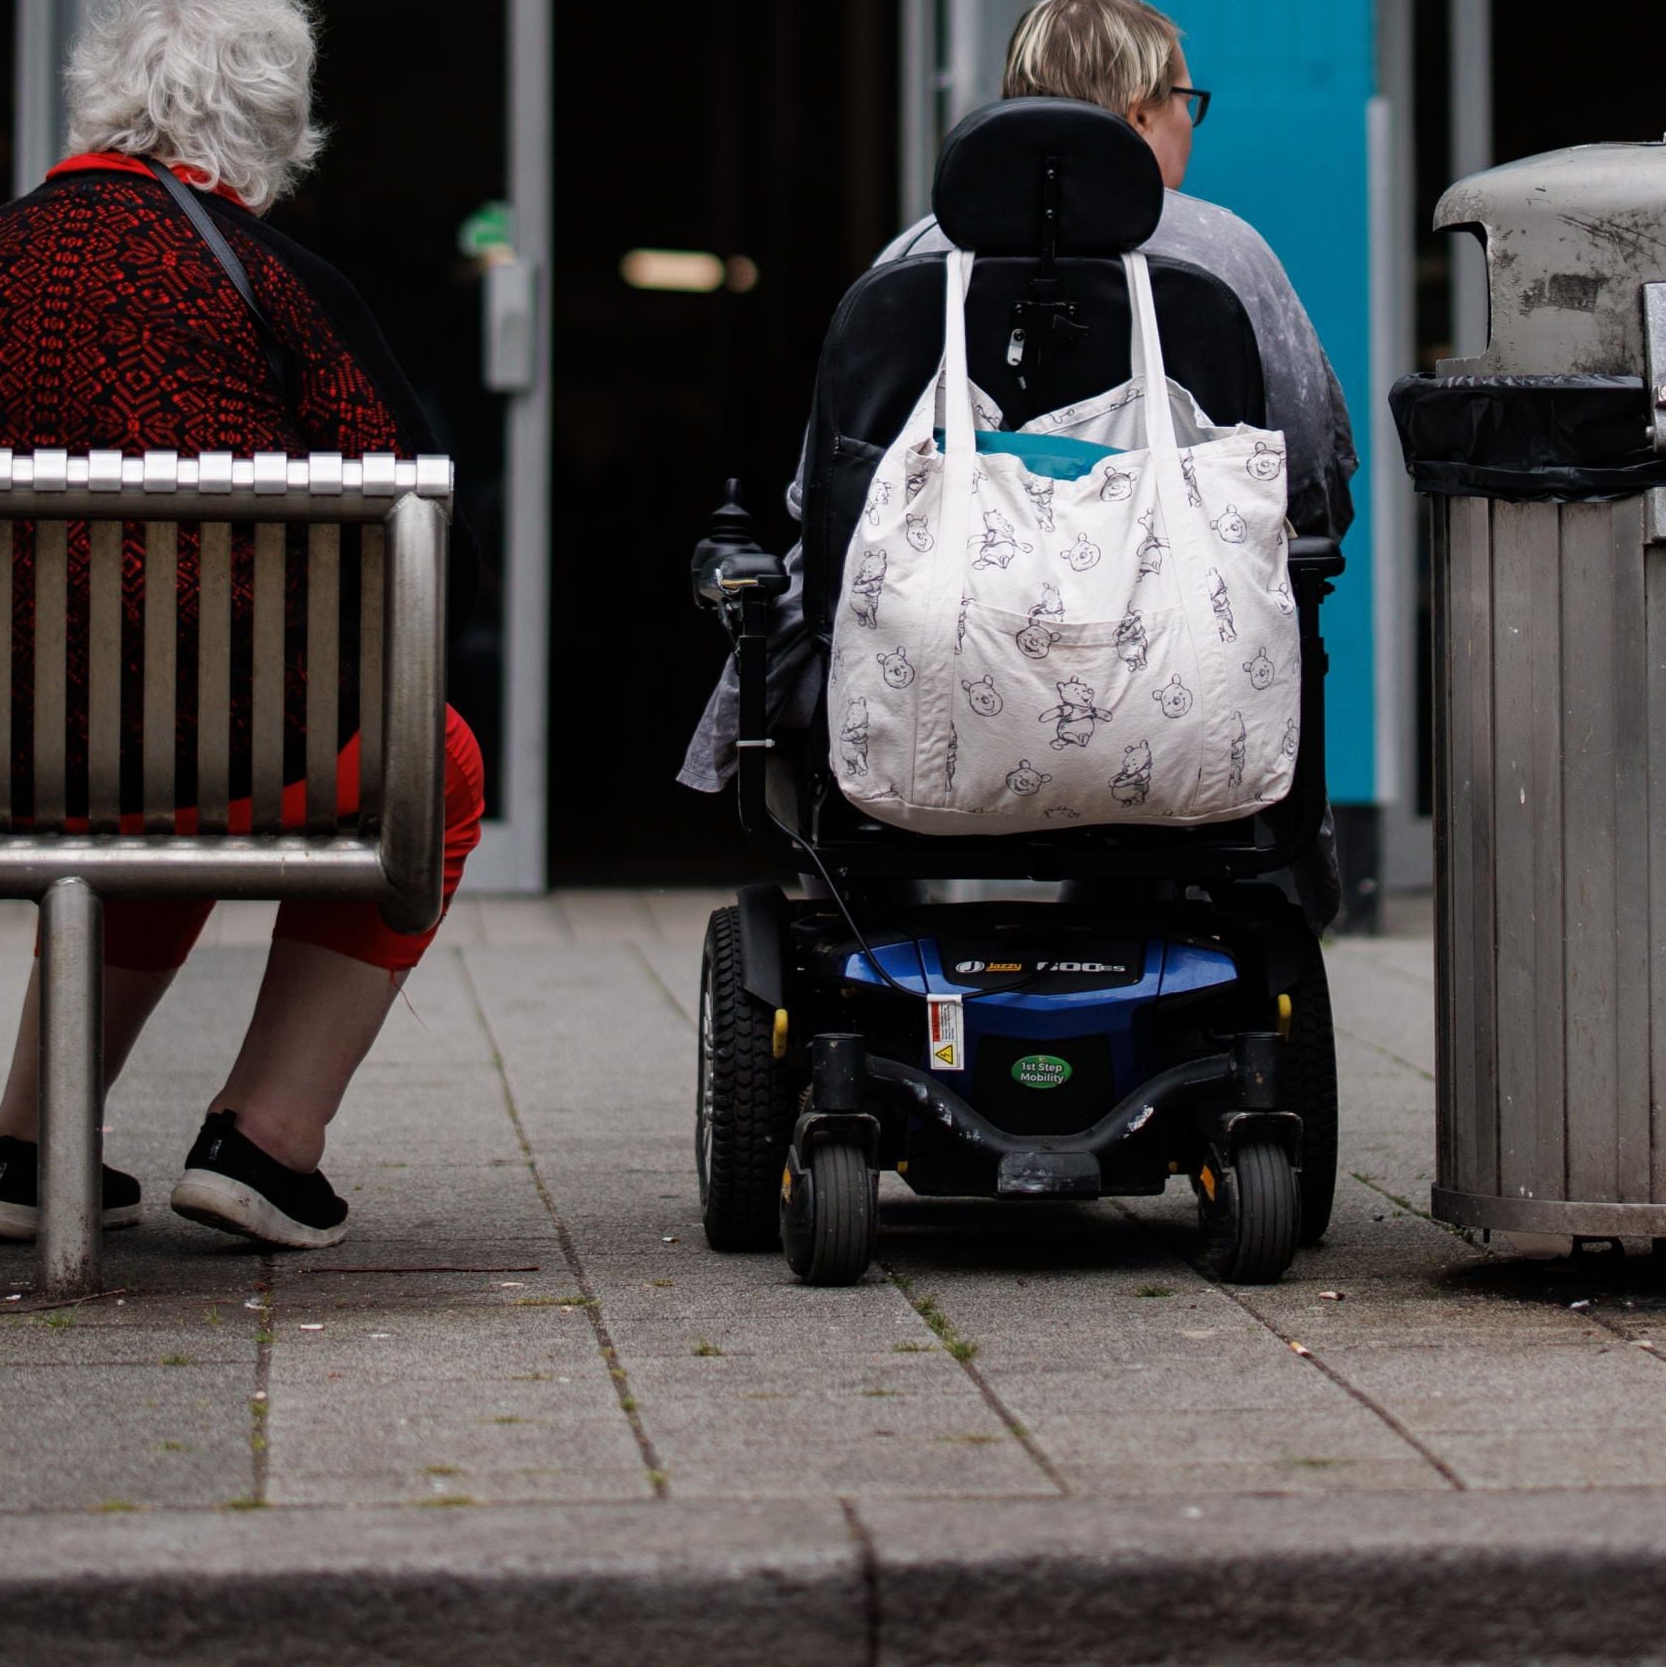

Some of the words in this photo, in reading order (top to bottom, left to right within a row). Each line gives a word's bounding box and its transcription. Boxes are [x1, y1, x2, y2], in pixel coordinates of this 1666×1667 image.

[985, 962, 1023, 972] Jazzy
[1021, 1062, 1036, 1072] 1st
[1037, 1062, 1063, 1074] Step
[1020, 1072, 1065, 1084] Mobility
